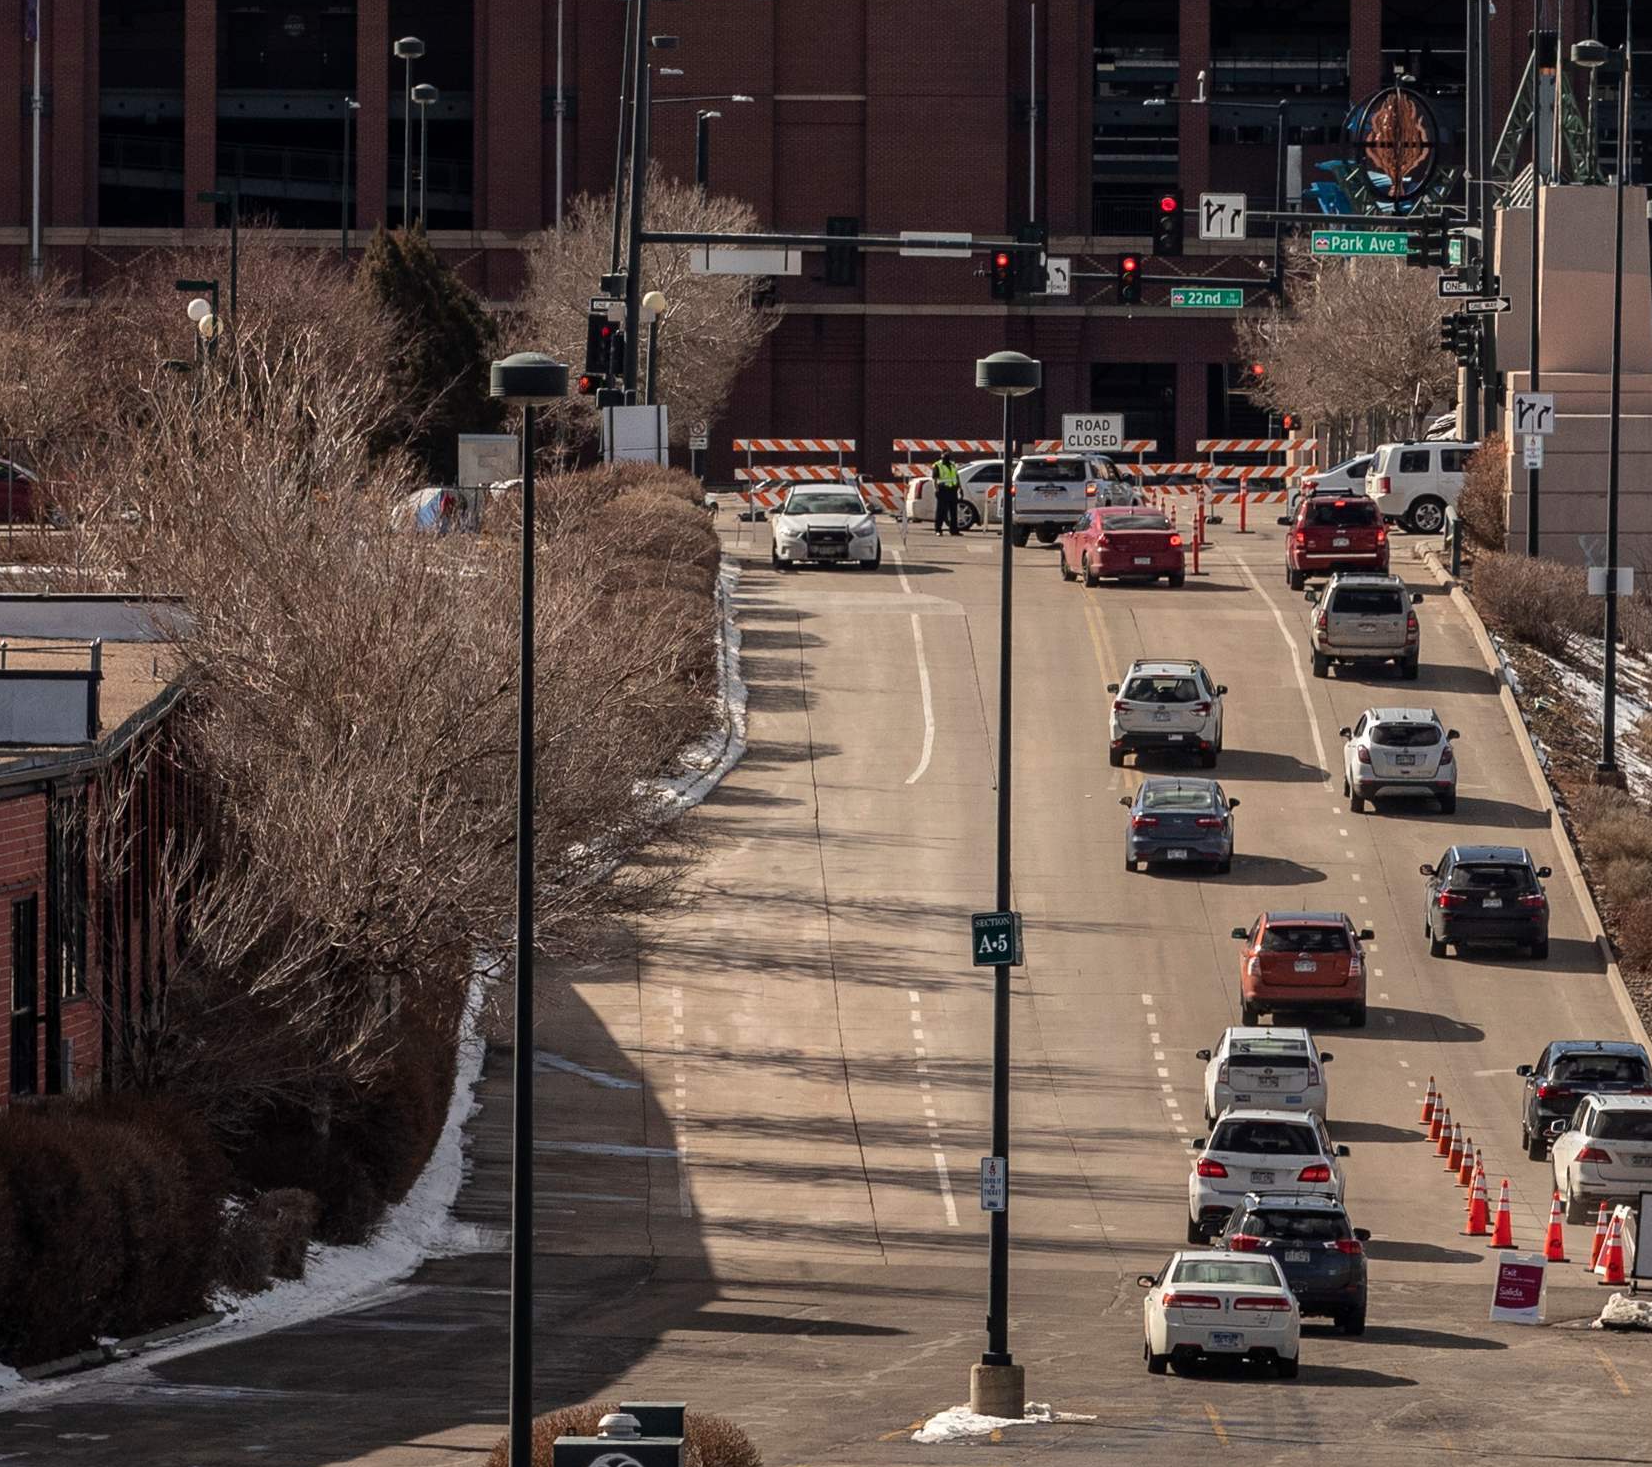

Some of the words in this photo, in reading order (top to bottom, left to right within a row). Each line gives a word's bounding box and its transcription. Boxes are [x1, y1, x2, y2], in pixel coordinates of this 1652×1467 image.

[1331, 235, 1367, 251] Park
[1370, 237, 1396, 252] Ave
[1187, 291, 1221, 305] 22nd
[1075, 419, 1110, 431] ROAD
[1068, 435, 1118, 447] CLOSED
[974, 916, 1010, 928] SECTION
[1502, 1266, 1516, 1277] Exit
[1498, 1285, 1522, 1297] Salida
